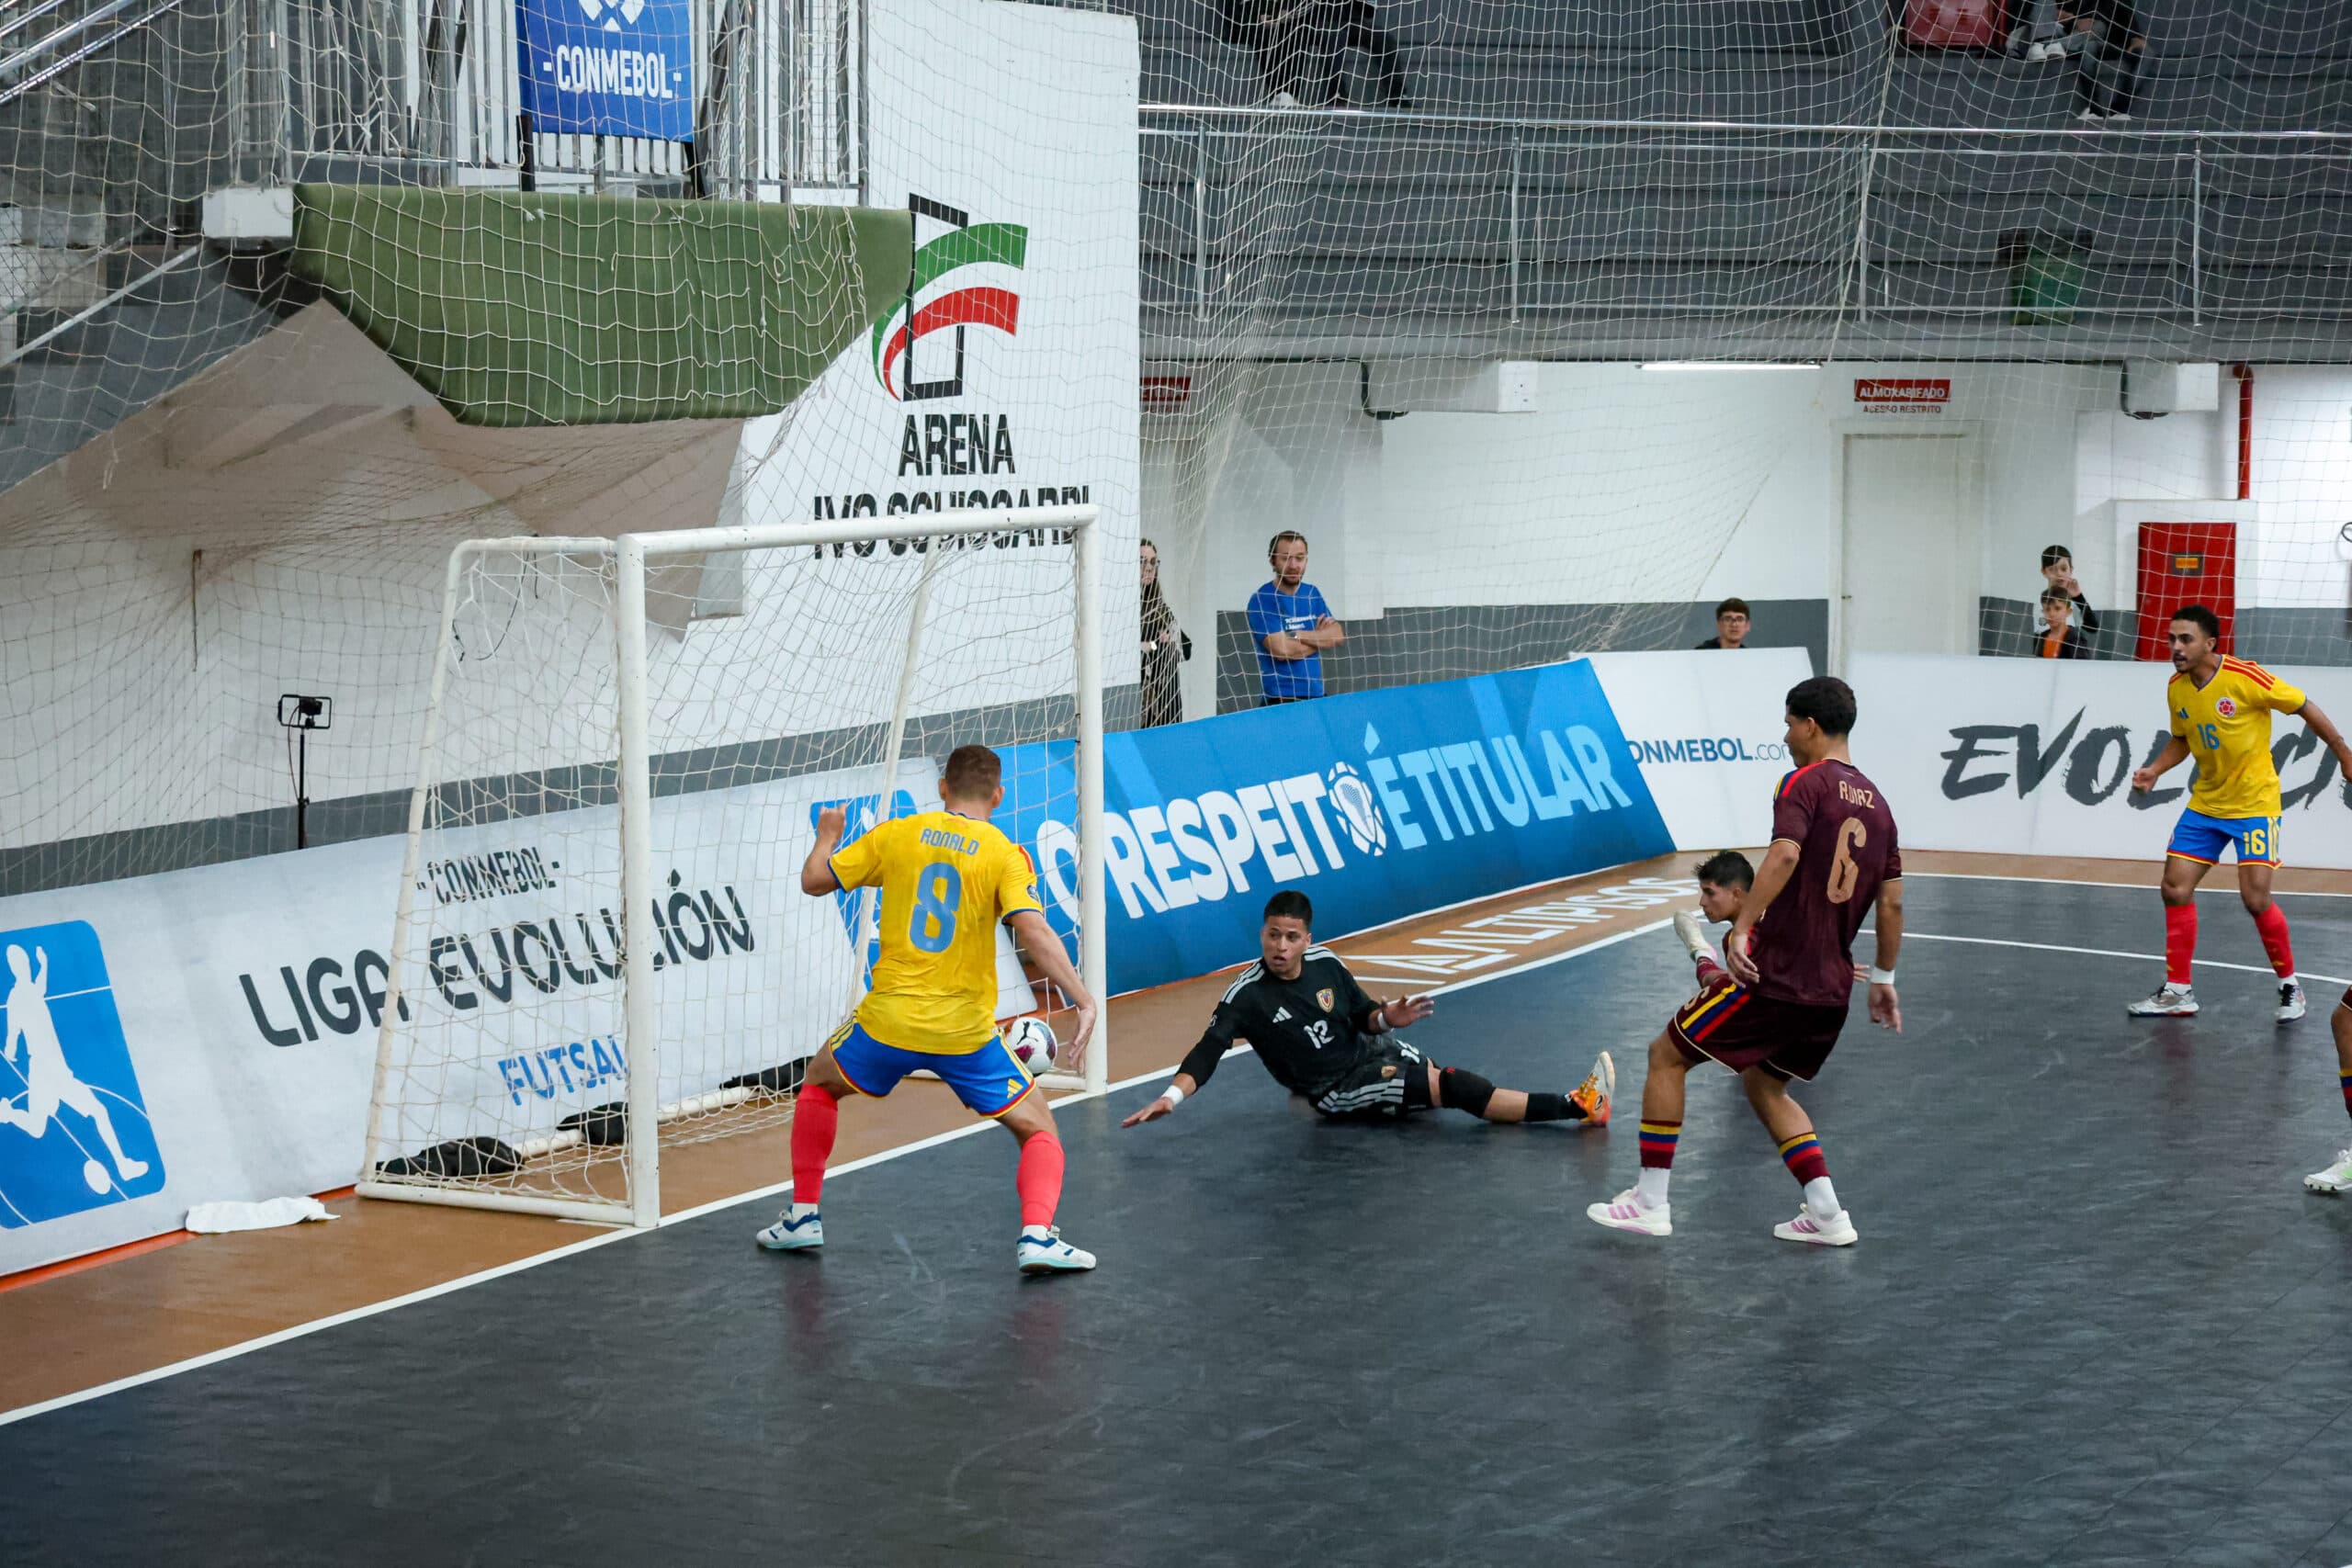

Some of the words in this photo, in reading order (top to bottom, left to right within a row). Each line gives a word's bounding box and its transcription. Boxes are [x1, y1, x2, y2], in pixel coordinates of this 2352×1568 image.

[1859, 387, 1945, 398] ALMOXARIFADO
[1899, 405, 1941, 413] RESTRITO
[898, 413, 1016, 477] ARENA
[814, 493, 876, 558] IVO
[1628, 738, 1789, 764] ONMEBOL.co
[2197, 723, 2220, 750] 16
[1363, 720, 1427, 851] É
[1398, 724, 1633, 842] TITULAR
[920, 828, 980, 856] RONALD
[2243, 829, 2267, 856] 16
[1826, 817, 1867, 904] 6
[909, 862, 963, 953] 8
[238, 949, 411, 1047] LIGA
[428, 868, 755, 1010] EVOLUIÓN
[1304, 1020, 1335, 1049] 12
